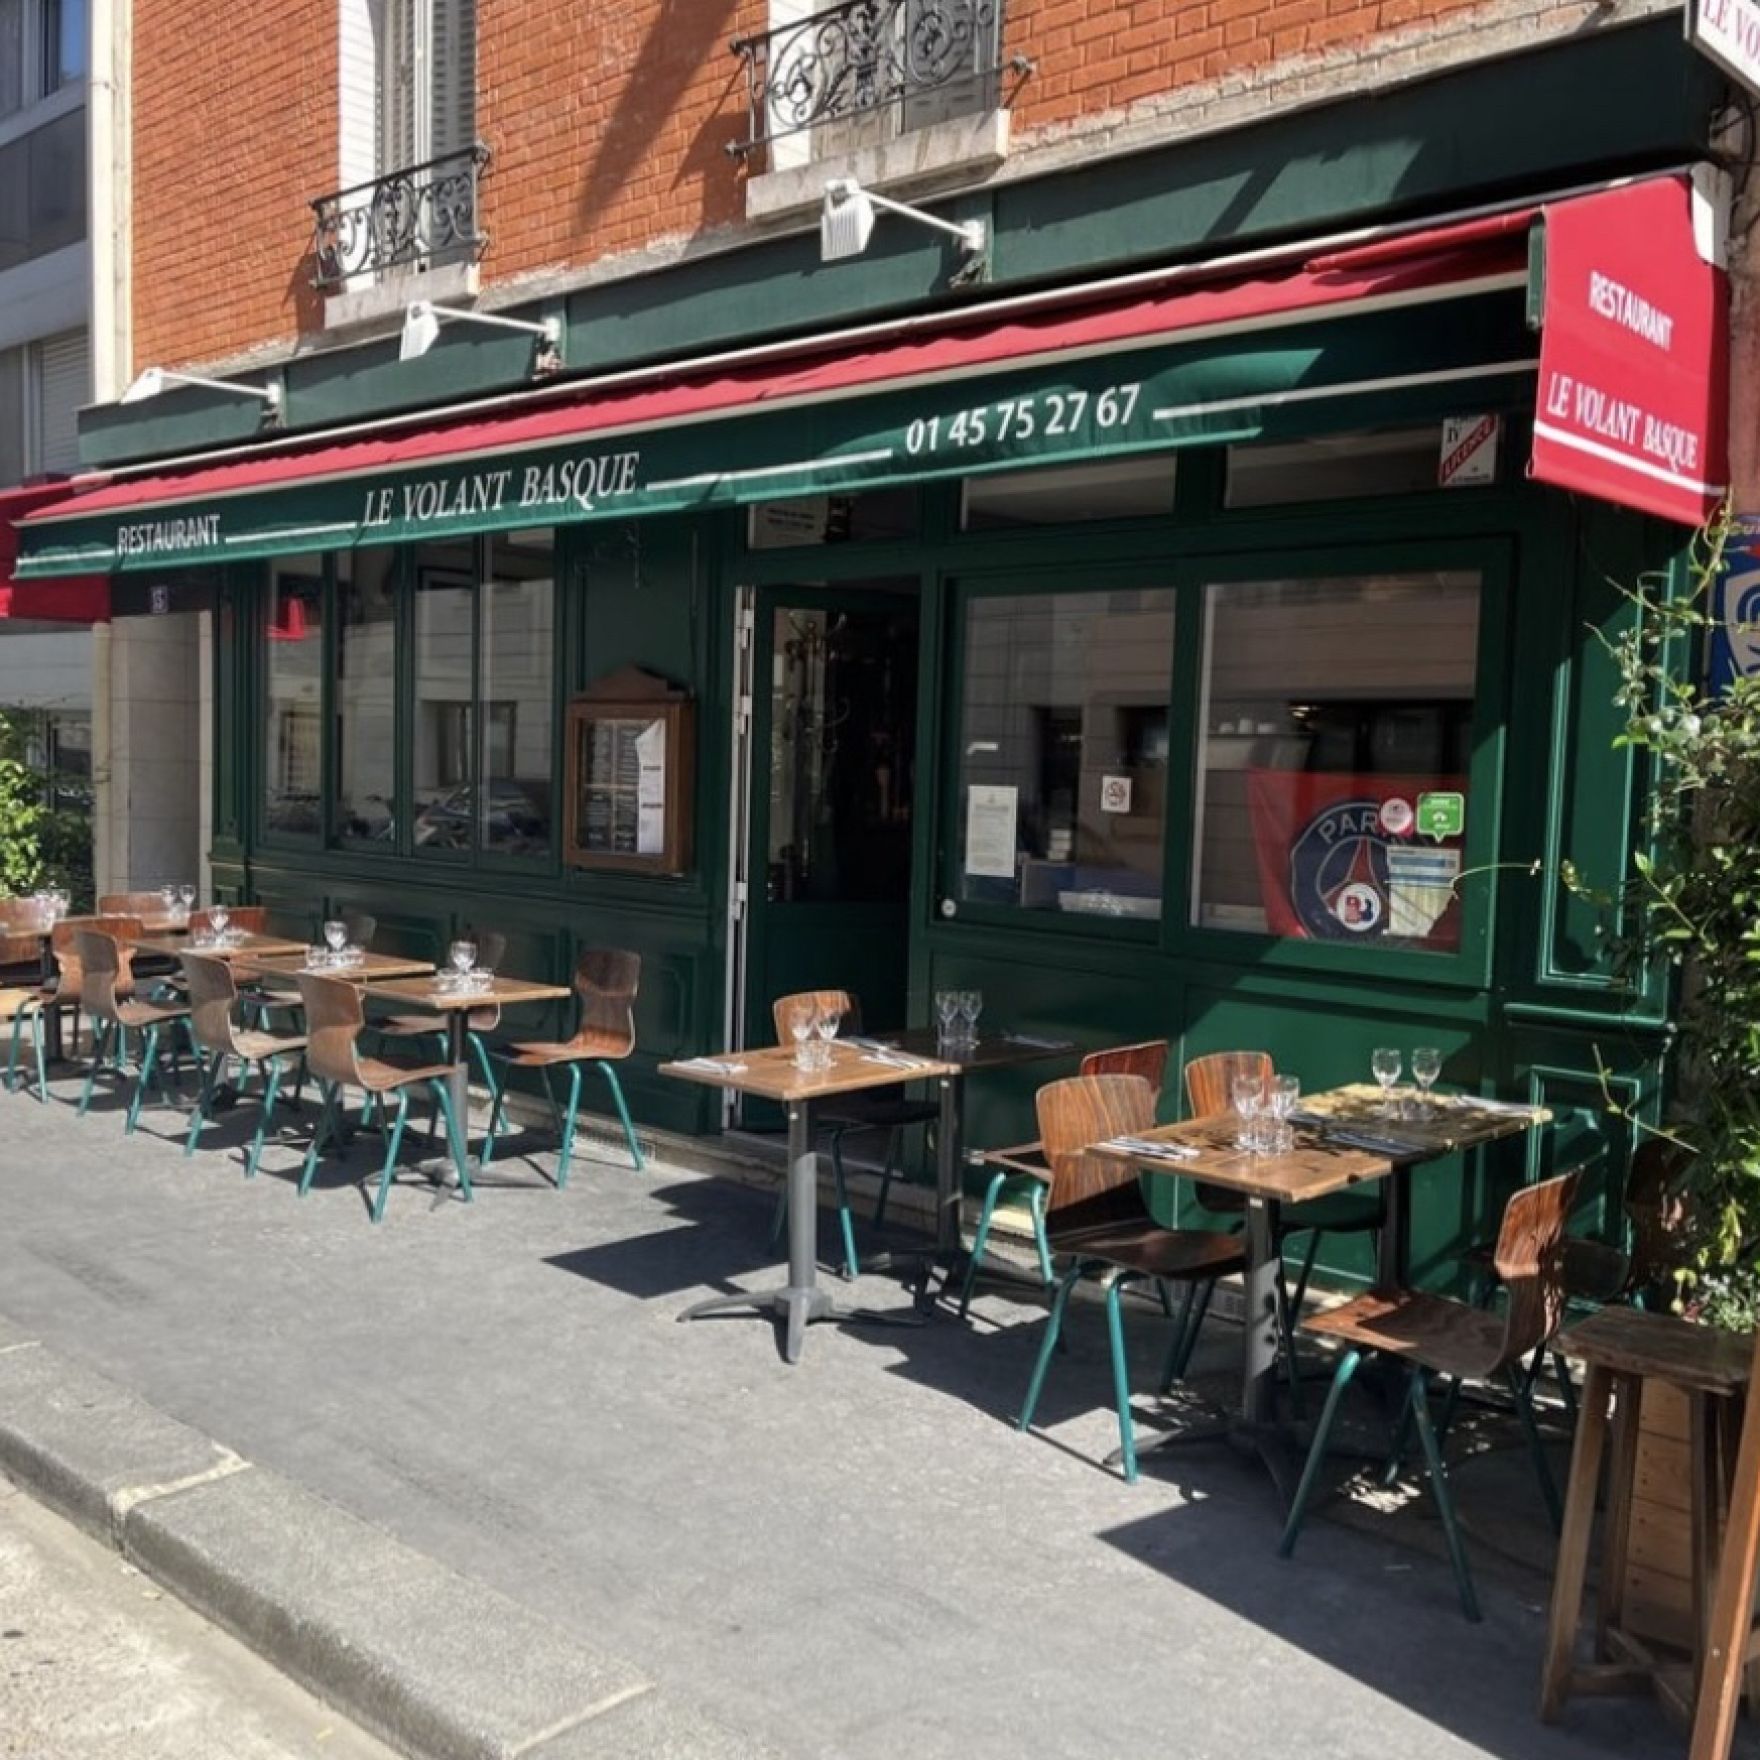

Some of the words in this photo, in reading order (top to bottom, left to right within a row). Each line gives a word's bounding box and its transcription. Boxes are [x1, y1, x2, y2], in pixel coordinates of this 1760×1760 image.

[1702, 0, 1728, 34] LE
[1732, 4, 1760, 64] VO
[1588, 269, 1673, 352] RESTAURANT
[906, 416, 941, 455] 01
[948, 407, 988, 446] 45
[996, 399, 1034, 441] 75
[1044, 391, 1089, 435] 27
[1096, 383, 1141, 427] 67
[1547, 371, 1573, 418] LE
[1575, 382, 1641, 446] VOLANT
[1643, 413, 1698, 473] BASQUE
[362, 487, 394, 527] LE
[403, 470, 513, 522] VOLANT
[519, 451, 640, 511] BASQUE
[117, 514, 221, 556] RESTAURANT
